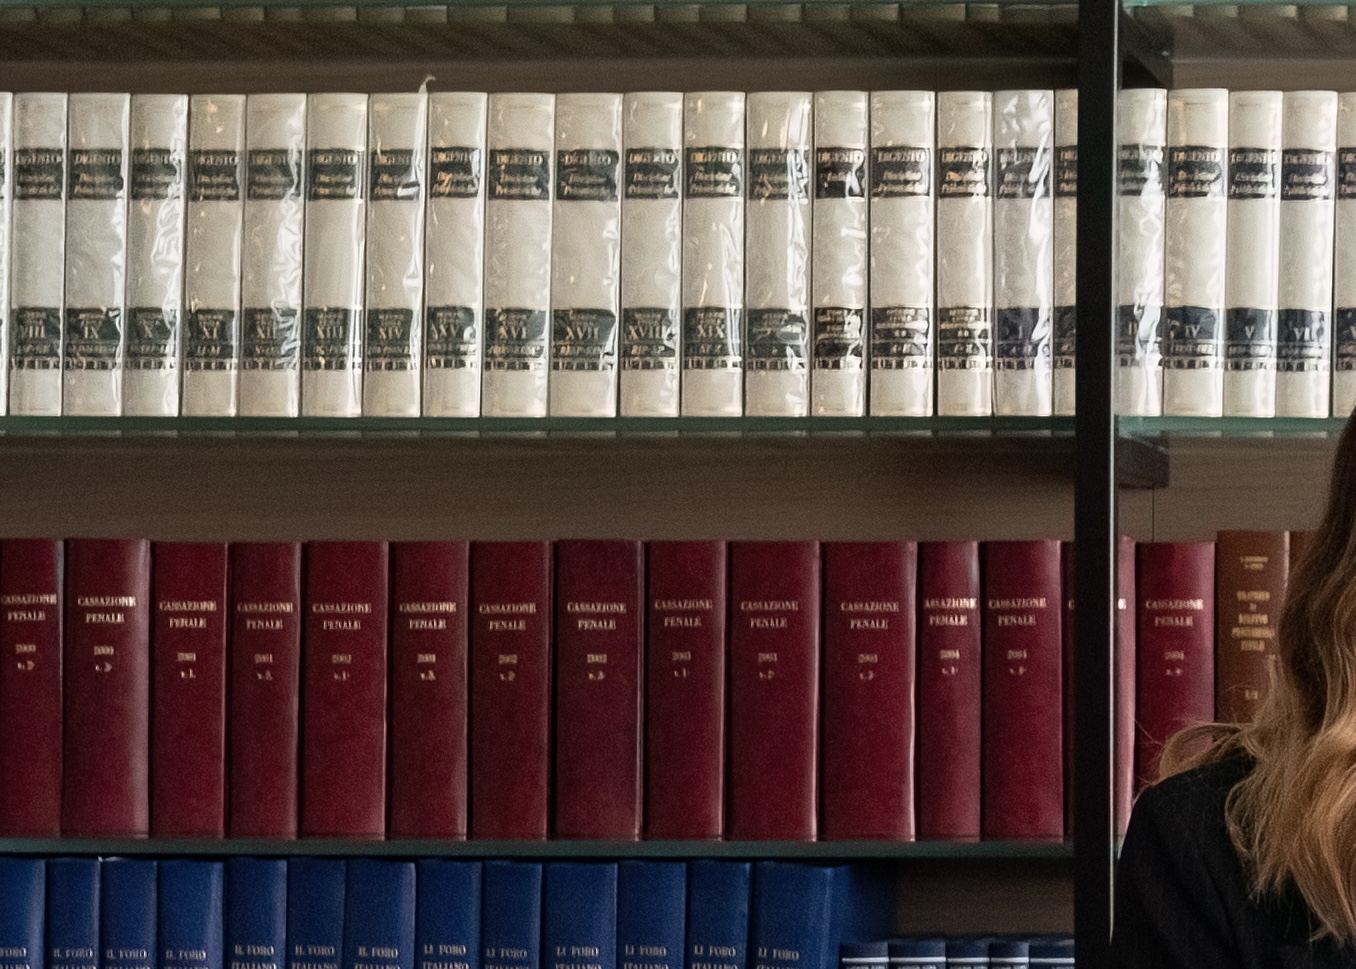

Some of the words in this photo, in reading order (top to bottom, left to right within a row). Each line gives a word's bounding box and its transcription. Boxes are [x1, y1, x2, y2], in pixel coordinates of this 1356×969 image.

[2, 594, 57, 605] ASSAZIONE
[78, 596, 136, 607] CASSAZIONE
[654, 599, 713, 610] CASSAZIONE
[923, 598, 977, 609] ASSAZIONE
[989, 598, 1047, 609] CASSAZIONE
[1146, 599, 1204, 610] CASSAZIONE
[160, 601, 217, 612] CASSAZIONE
[237, 602, 294, 613] CASSAZIONE
[313, 602, 372, 614] CASSAZIONE
[400, 602, 457, 613] CASSAZIONE
[479, 602, 536, 614] CASSAZIONE
[567, 602, 627, 614] CASSAZIONE
[741, 600, 799, 611] CASSAZIONE
[841, 601, 900, 612] CASSAZIONE
[8, 611, 46, 621] PENALE
[86, 613, 124, 623] PENALE
[664, 616, 702, 627] PENALE
[929, 615, 968, 626] PENALE
[998, 615, 1036, 627] PENALE
[1155, 616, 1193, 627] PENALE
[169, 618, 206, 628] PENALE
[246, 620, 283, 630] PENALE
[323, 620, 361, 630] PENALE
[409, 619, 446, 629] PENALE
[489, 620, 526, 630] PENALE
[578, 620, 616, 630] PENALE
[750, 617, 788, 628] PENALE
[850, 619, 889, 630] PENALE
[65, 948, 94, 958] FORO
[119, 948, 147, 959] FORO
[179, 949, 206, 960] FORO
[247, 945, 274, 955] FORO
[308, 945, 335, 956] FORO
[371, 946, 399, 958] FORO
[439, 944, 467, 955] FORO
[501, 948, 528, 959] FORO
[571, 947, 599, 957] FORO
[639, 946, 667, 957] FORO
[709, 946, 737, 957] FORO
[772, 948, 800, 960] FORO
